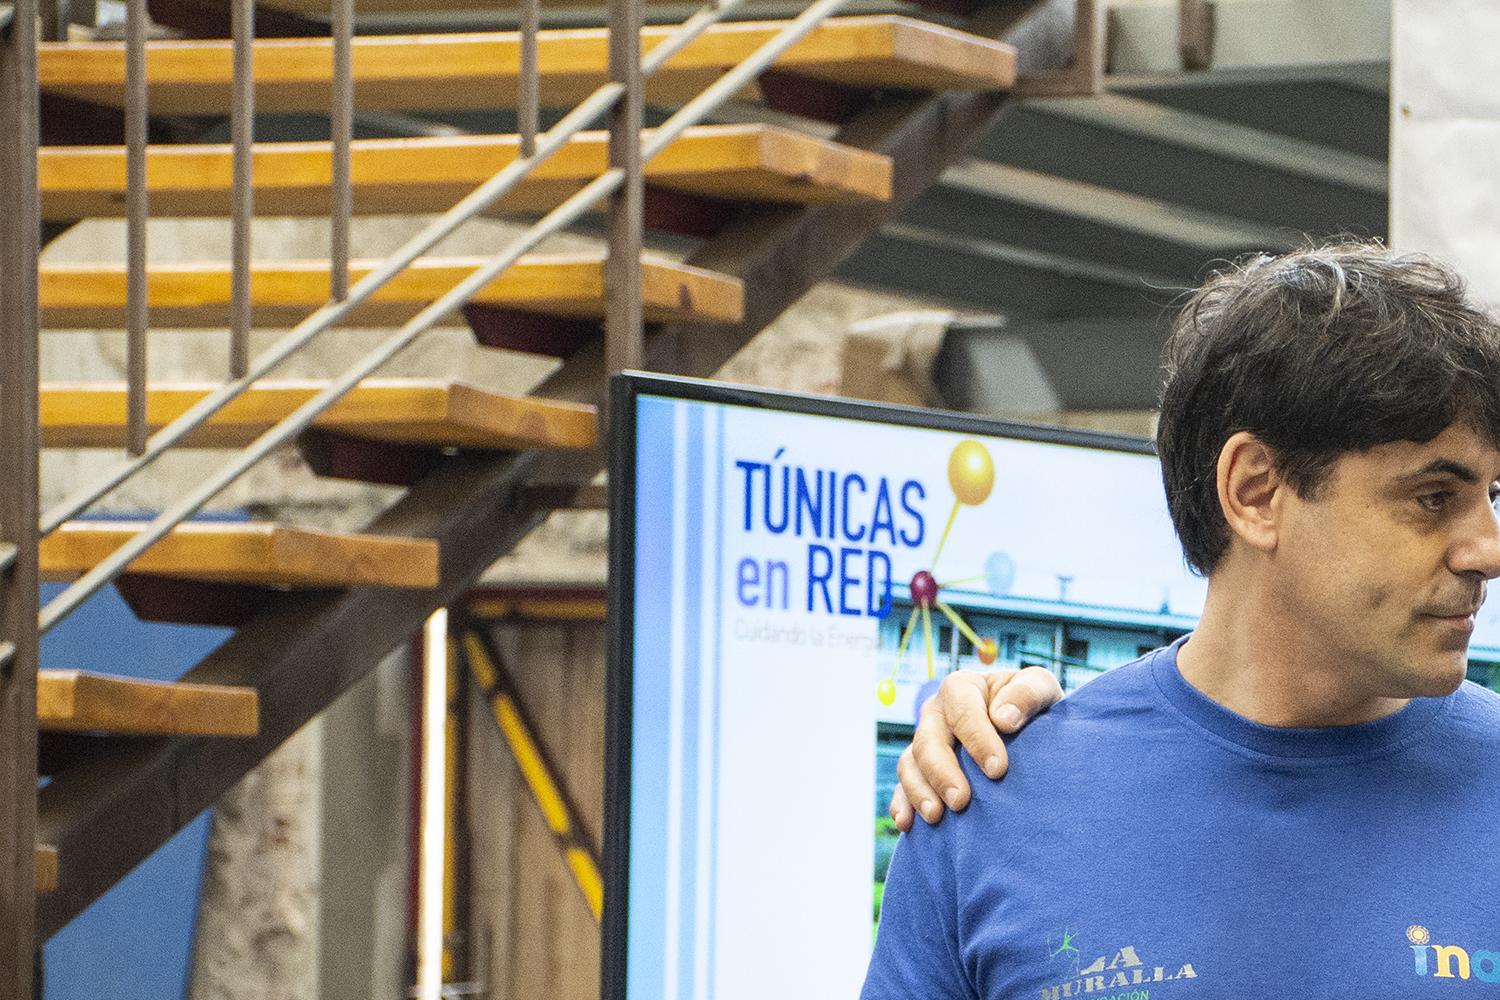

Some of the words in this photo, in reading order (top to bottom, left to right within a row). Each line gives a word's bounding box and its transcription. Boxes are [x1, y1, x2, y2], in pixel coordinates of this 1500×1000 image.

[736, 448, 925, 547] TÚNICAS
[737, 557, 788, 609] en
[808, 544, 893, 618] RED
[1080, 945, 1144, 976] LA
